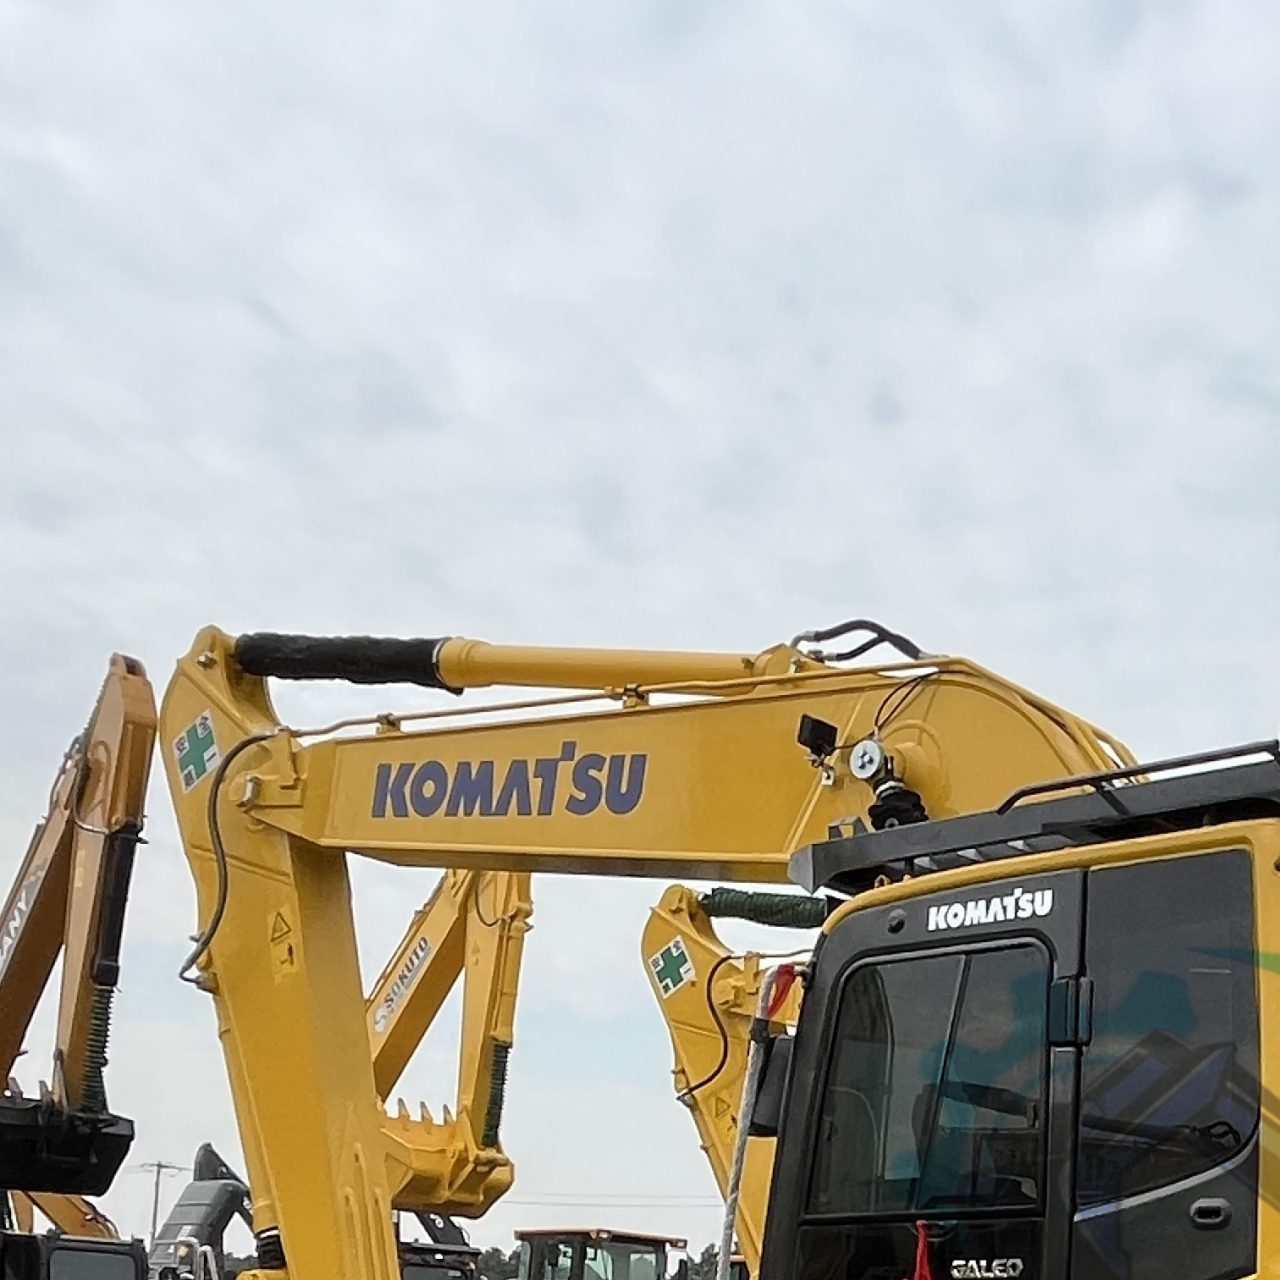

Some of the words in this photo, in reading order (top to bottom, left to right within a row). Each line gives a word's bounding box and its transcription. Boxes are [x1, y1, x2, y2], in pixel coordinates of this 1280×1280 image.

[371, 740, 648, 818] KOMATSU
[0, 889, 27, 966] ANY
[927, 887, 1054, 931] KOMATSU
[383, 936, 429, 1014] SOKUTO
[950, 1257, 1025, 1279] GALEO
